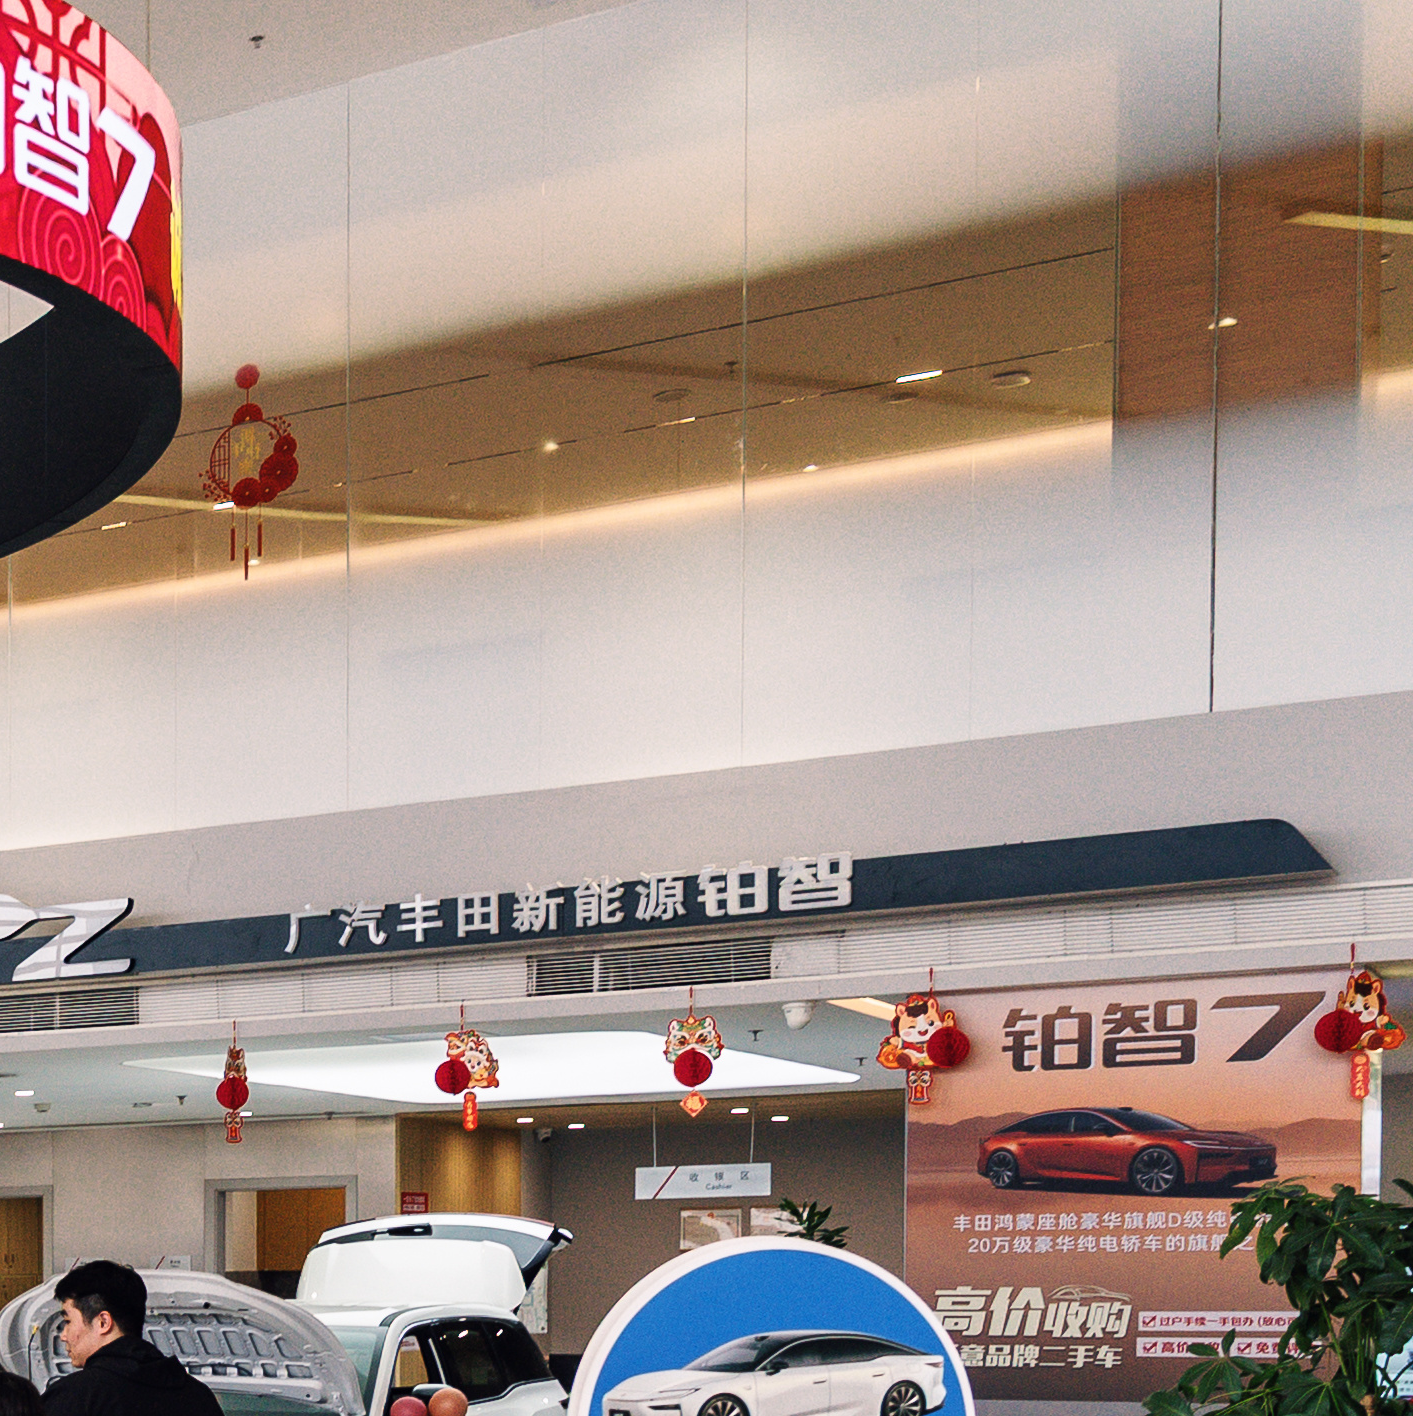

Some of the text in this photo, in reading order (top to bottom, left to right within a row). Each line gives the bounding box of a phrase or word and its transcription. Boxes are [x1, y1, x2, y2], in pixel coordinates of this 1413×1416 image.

[1002, 991, 1326, 1072] 铂智7
[935, 1285, 1133, 1339] 高价收购
[955, 1344, 1123, 1370] 意品牌二手车
